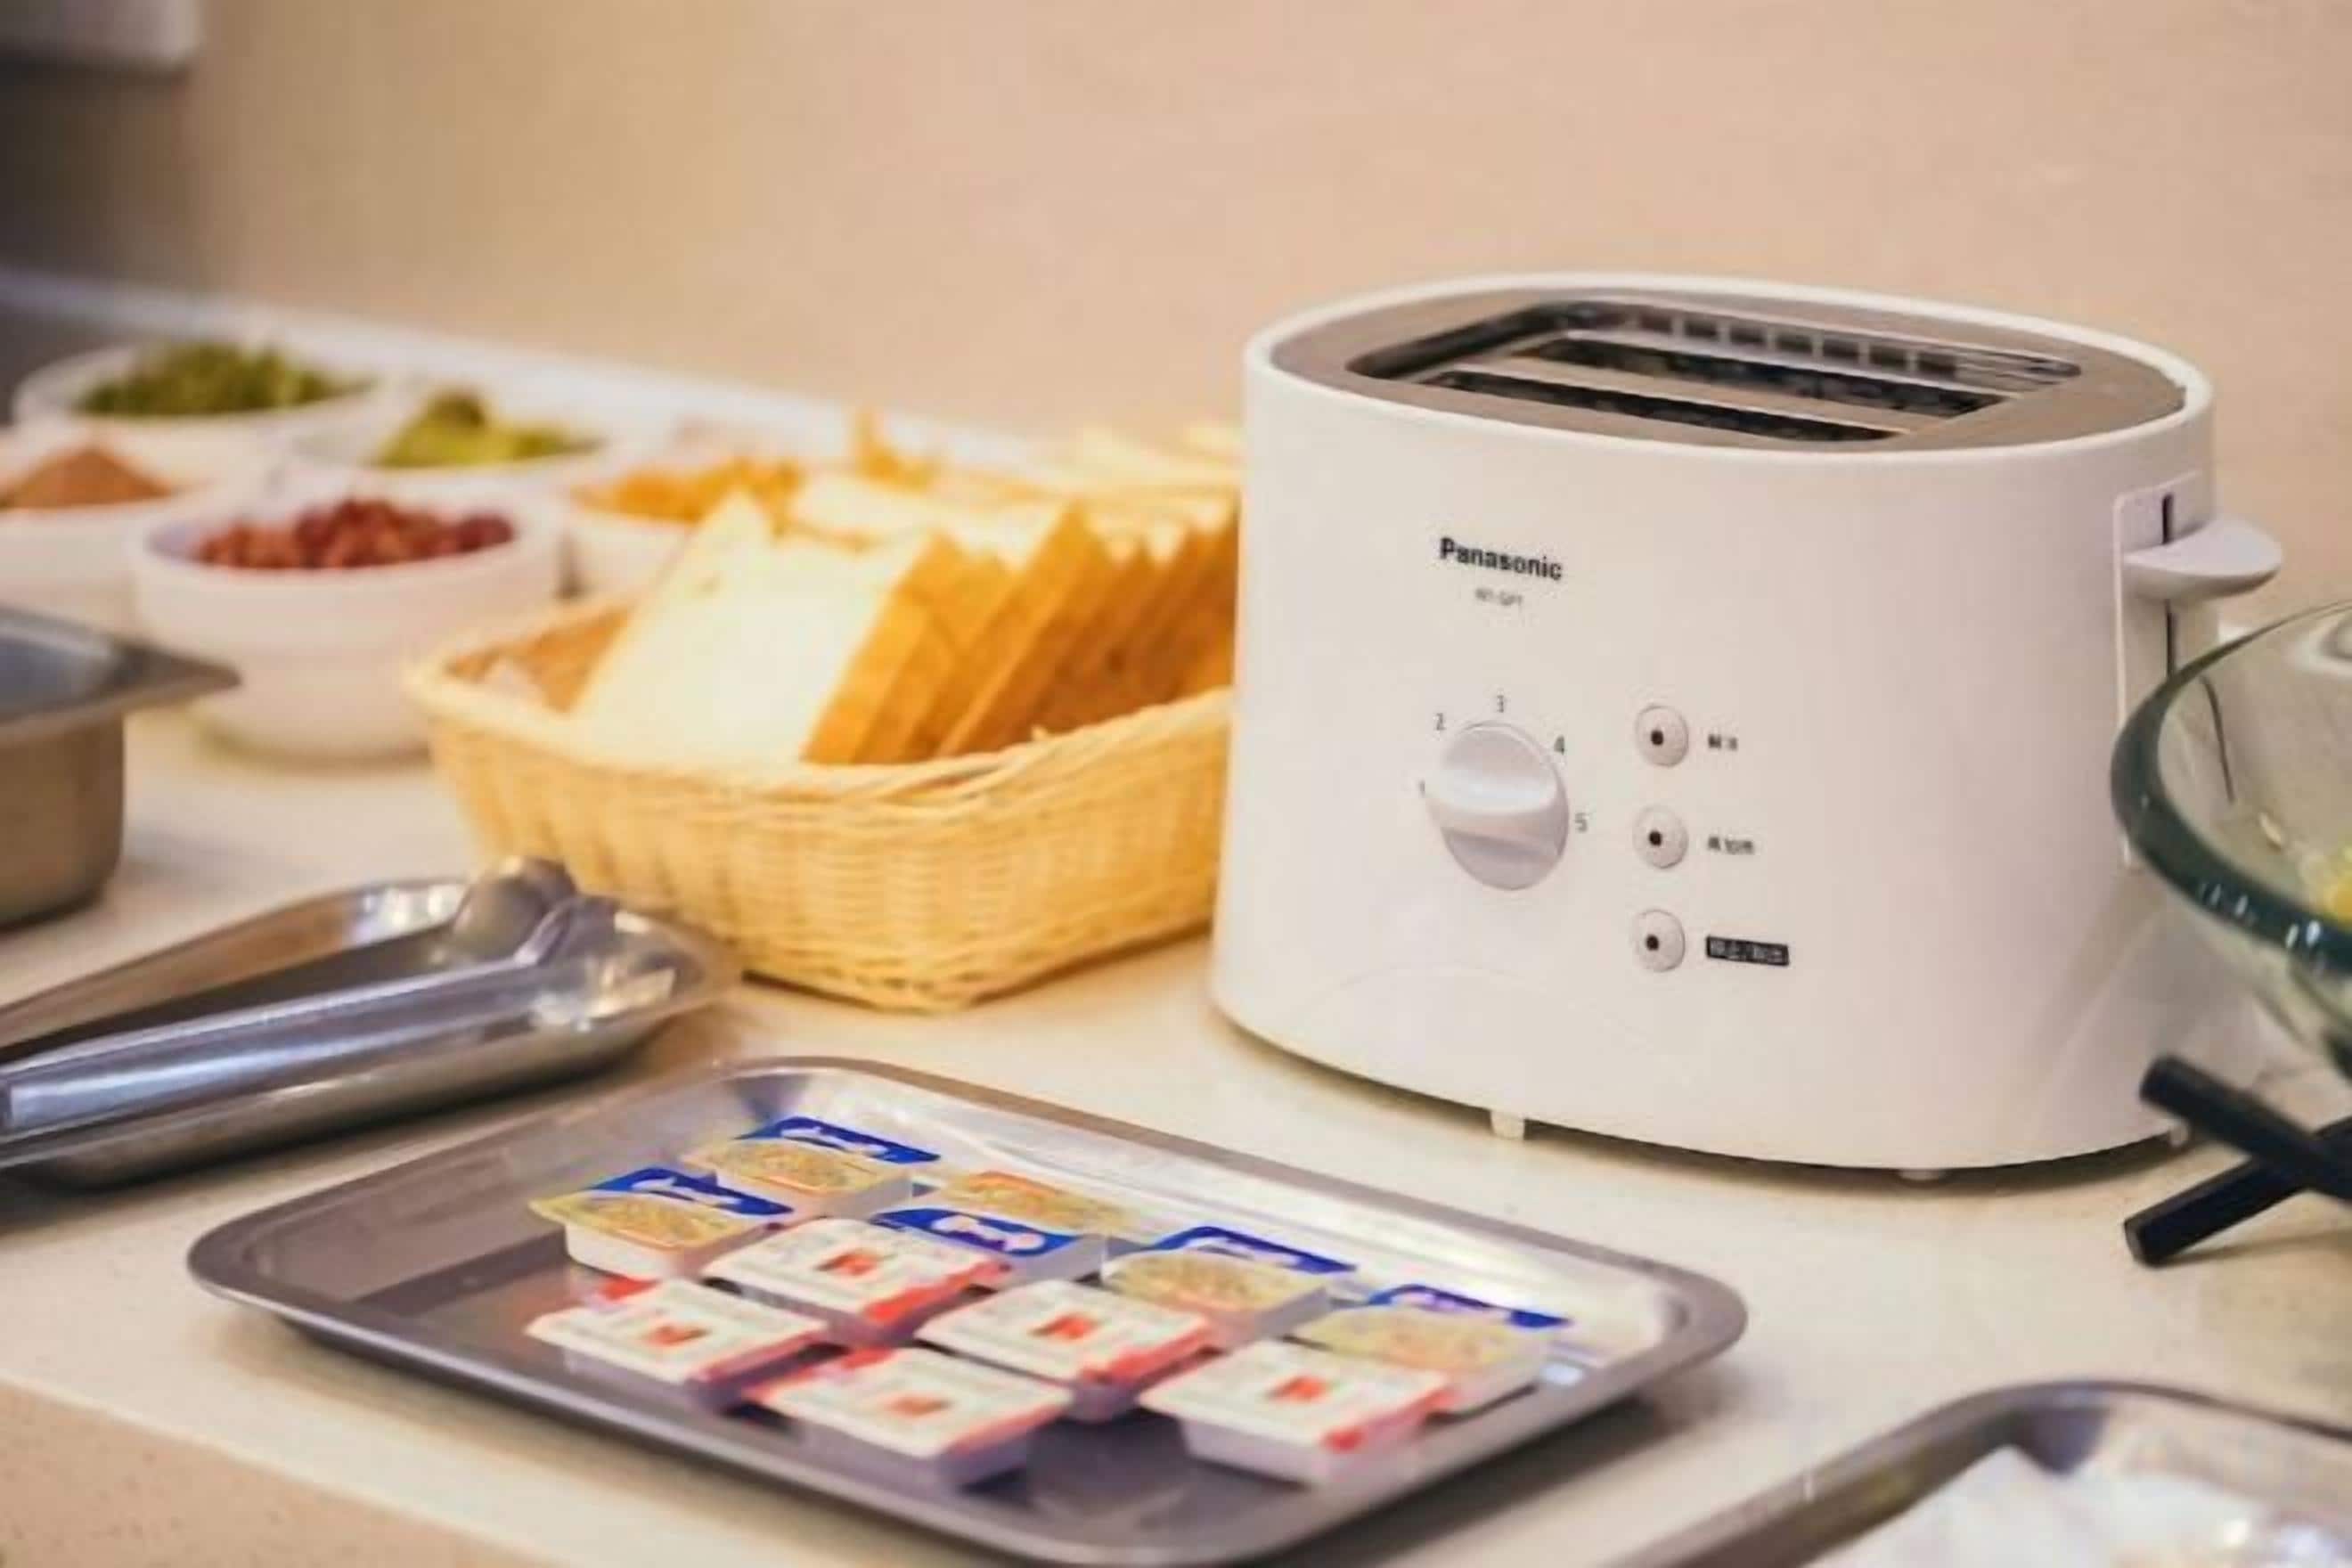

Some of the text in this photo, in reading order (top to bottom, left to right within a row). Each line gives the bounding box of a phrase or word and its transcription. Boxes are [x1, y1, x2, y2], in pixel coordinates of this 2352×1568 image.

[1439, 535, 1563, 582] Panasonic
[1496, 694, 1507, 714] 3
[1435, 712, 1446, 731] 2
[1553, 735, 1566, 755] 4
[1574, 812, 1588, 833] 5
